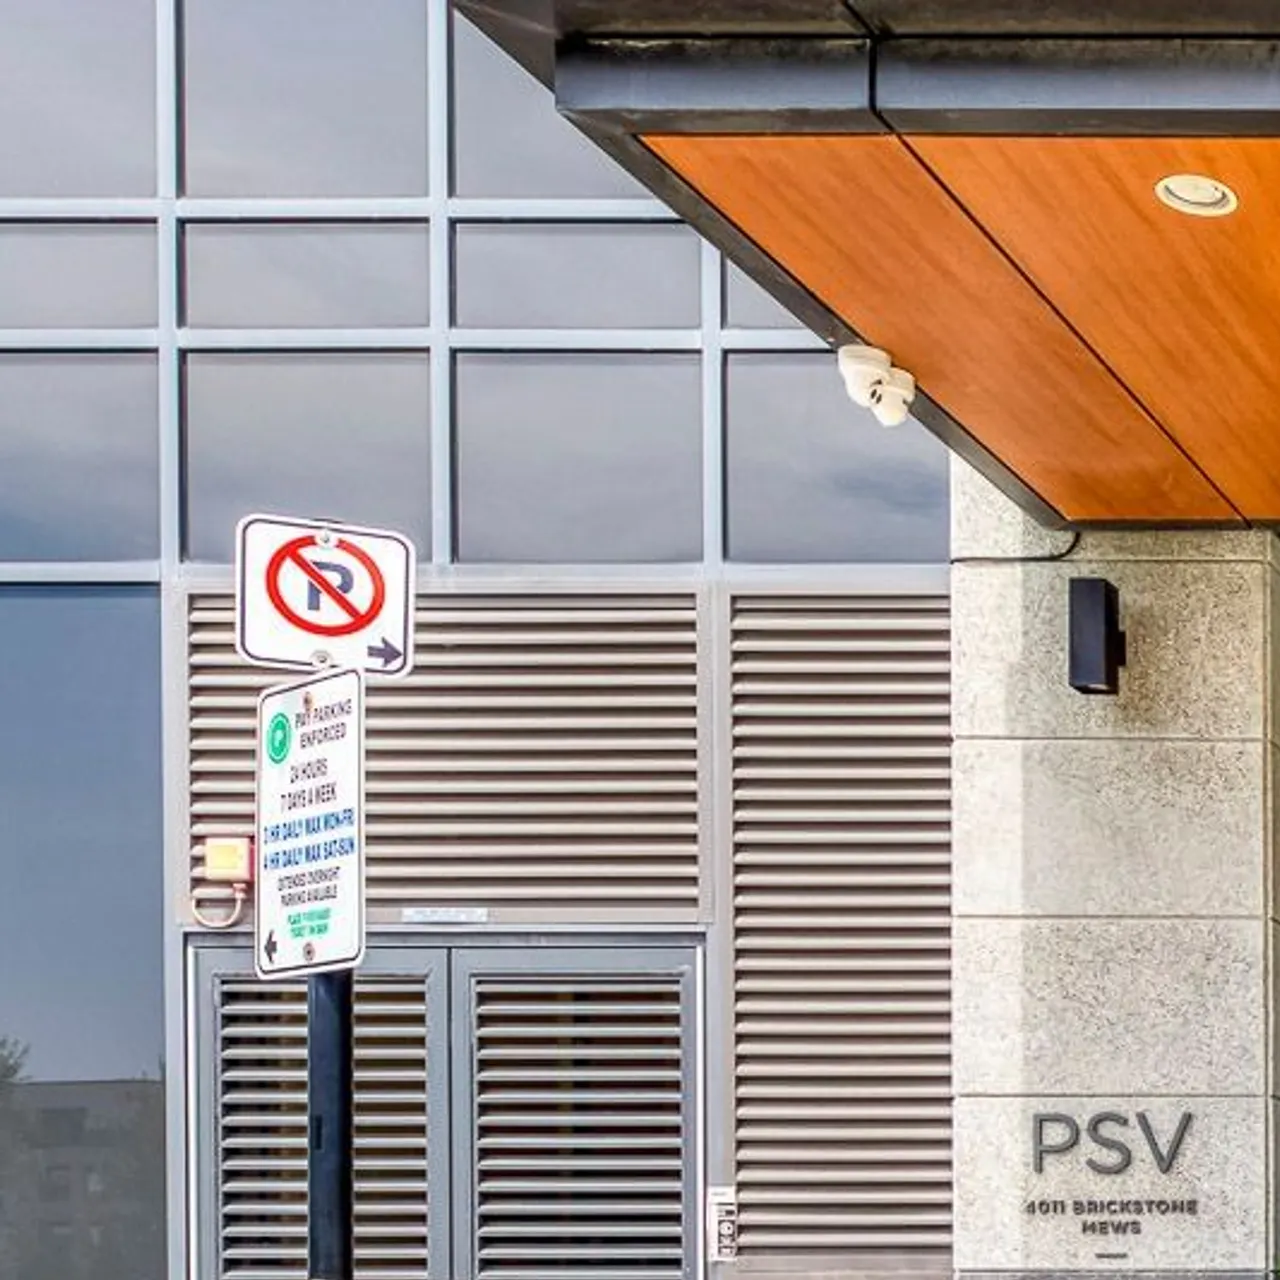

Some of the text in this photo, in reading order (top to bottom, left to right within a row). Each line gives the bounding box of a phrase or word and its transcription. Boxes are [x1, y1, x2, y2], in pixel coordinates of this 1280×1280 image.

[313, 698, 352, 723] PARKING
[301, 722, 347, 748] ENFORCED
[301, 758, 327, 780] HOURS
[287, 788, 306, 810] DAYS
[315, 782, 337, 804] WEEK
[282, 818, 303, 840] DAILY
[282, 846, 303, 867] DAILY
[1032, 1111, 1193, 1175] PSV
[1025, 1200, 1198, 1215] 4011 BRICKSTONE
[1082, 1220, 1142, 1235] MEWS
